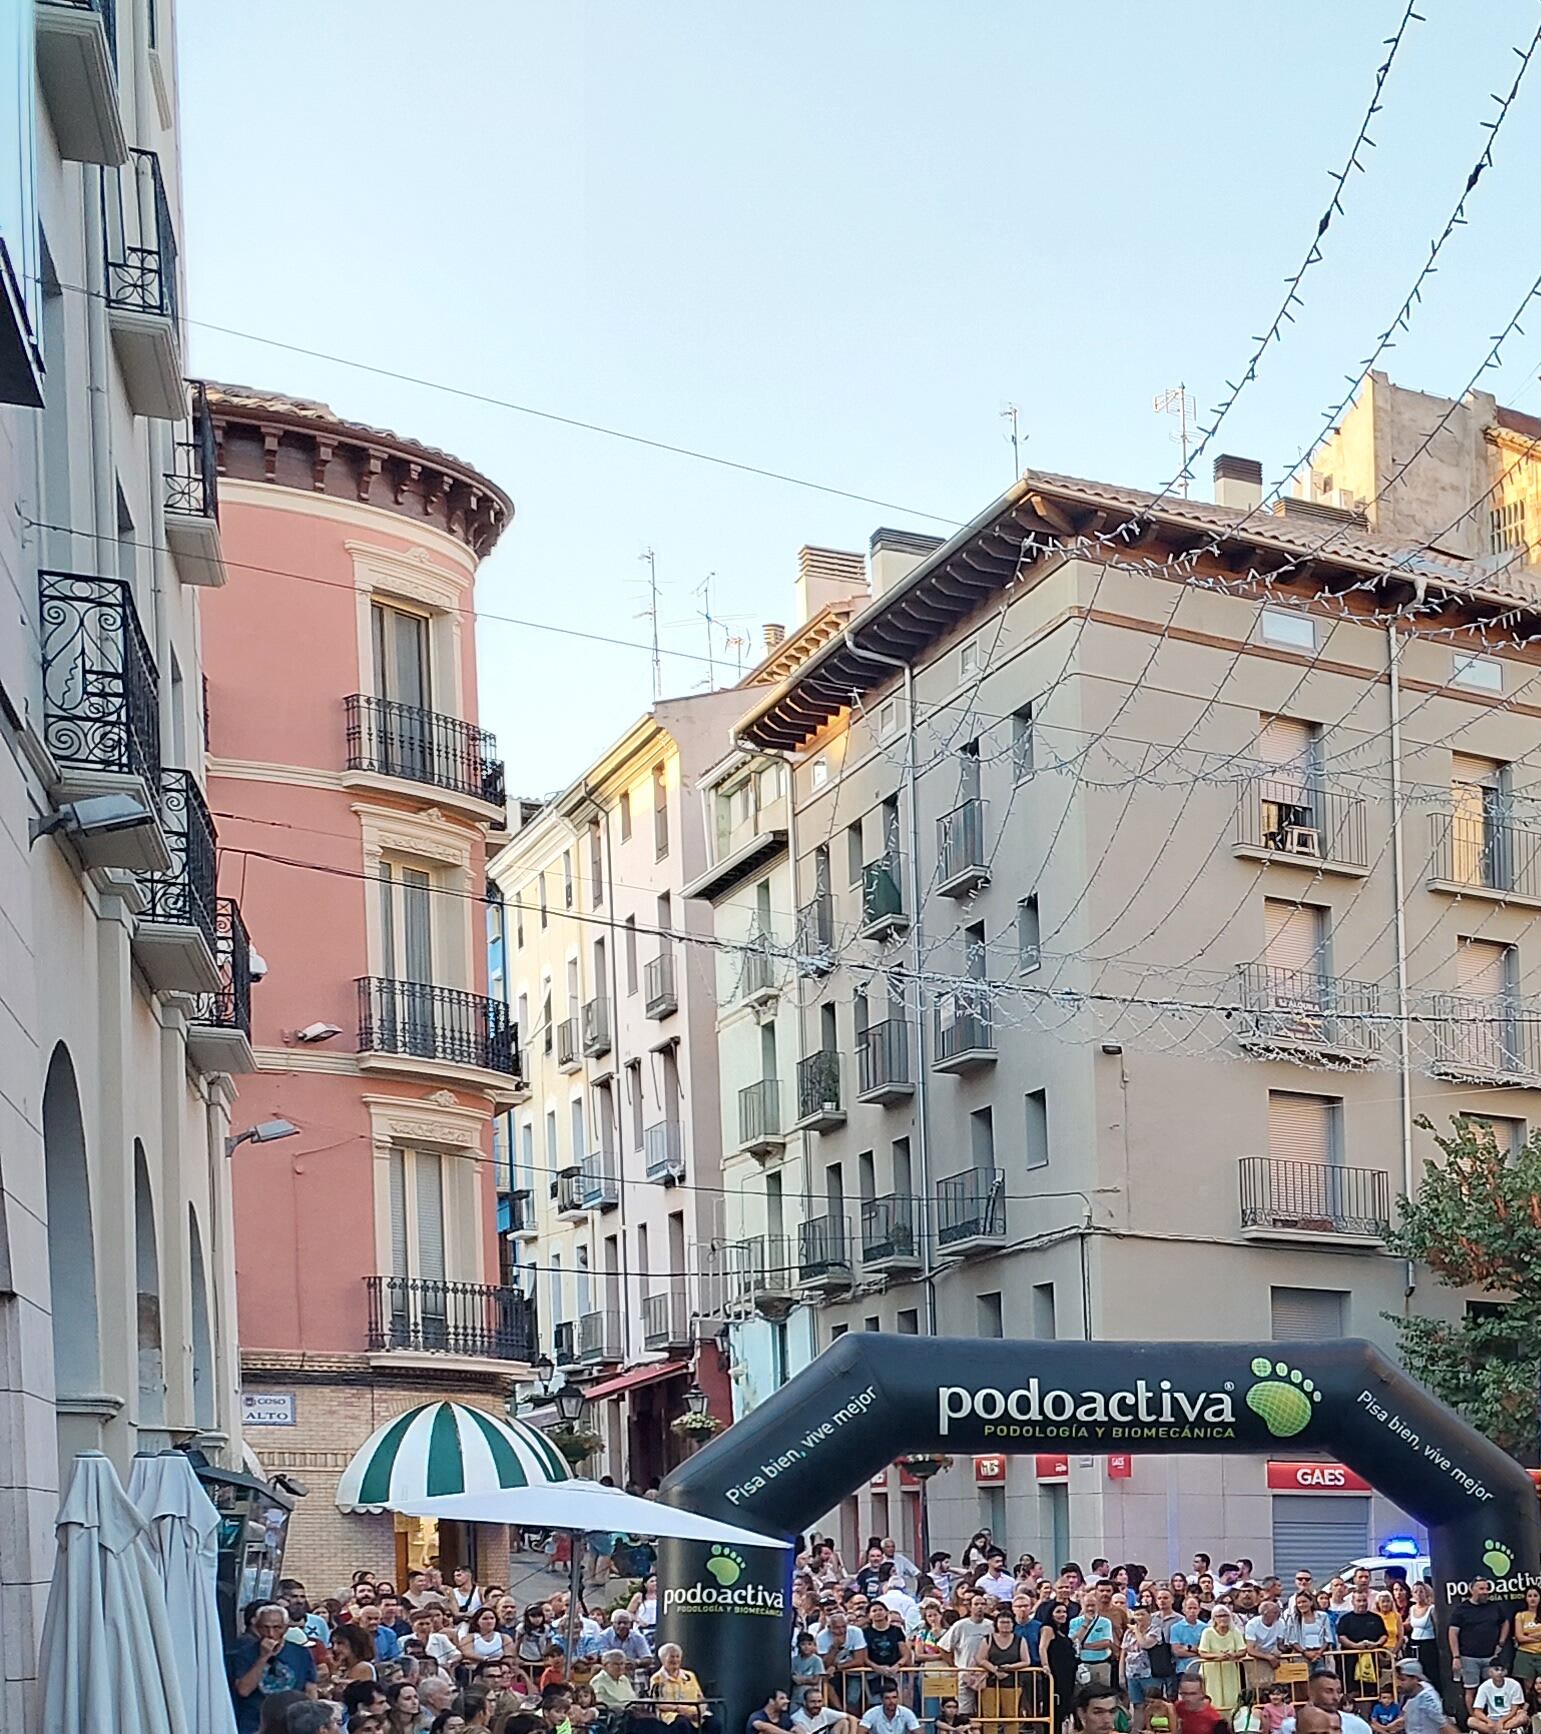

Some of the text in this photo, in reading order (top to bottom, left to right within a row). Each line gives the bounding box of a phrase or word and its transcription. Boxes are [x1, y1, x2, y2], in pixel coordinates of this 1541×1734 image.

[257, 1398, 286, 1406] COSO
[938, 1378, 1237, 1436] podoactiva
[245, 1412, 289, 1420] ALTO
[984, 1423, 1237, 1440] PODOLOGÍA Y BIOMECÁNICA
[725, 1385, 878, 1506] Pisa bien, vive mejor
[1356, 1389, 1496, 1502] Pisa bien, vive mejor
[1296, 1468, 1346, 1487] GAES
[663, 1581, 783, 1615] podoactiva
[676, 1604, 723, 1614] PODOLOGÍA
[726, 1605, 733, 1614] Y
